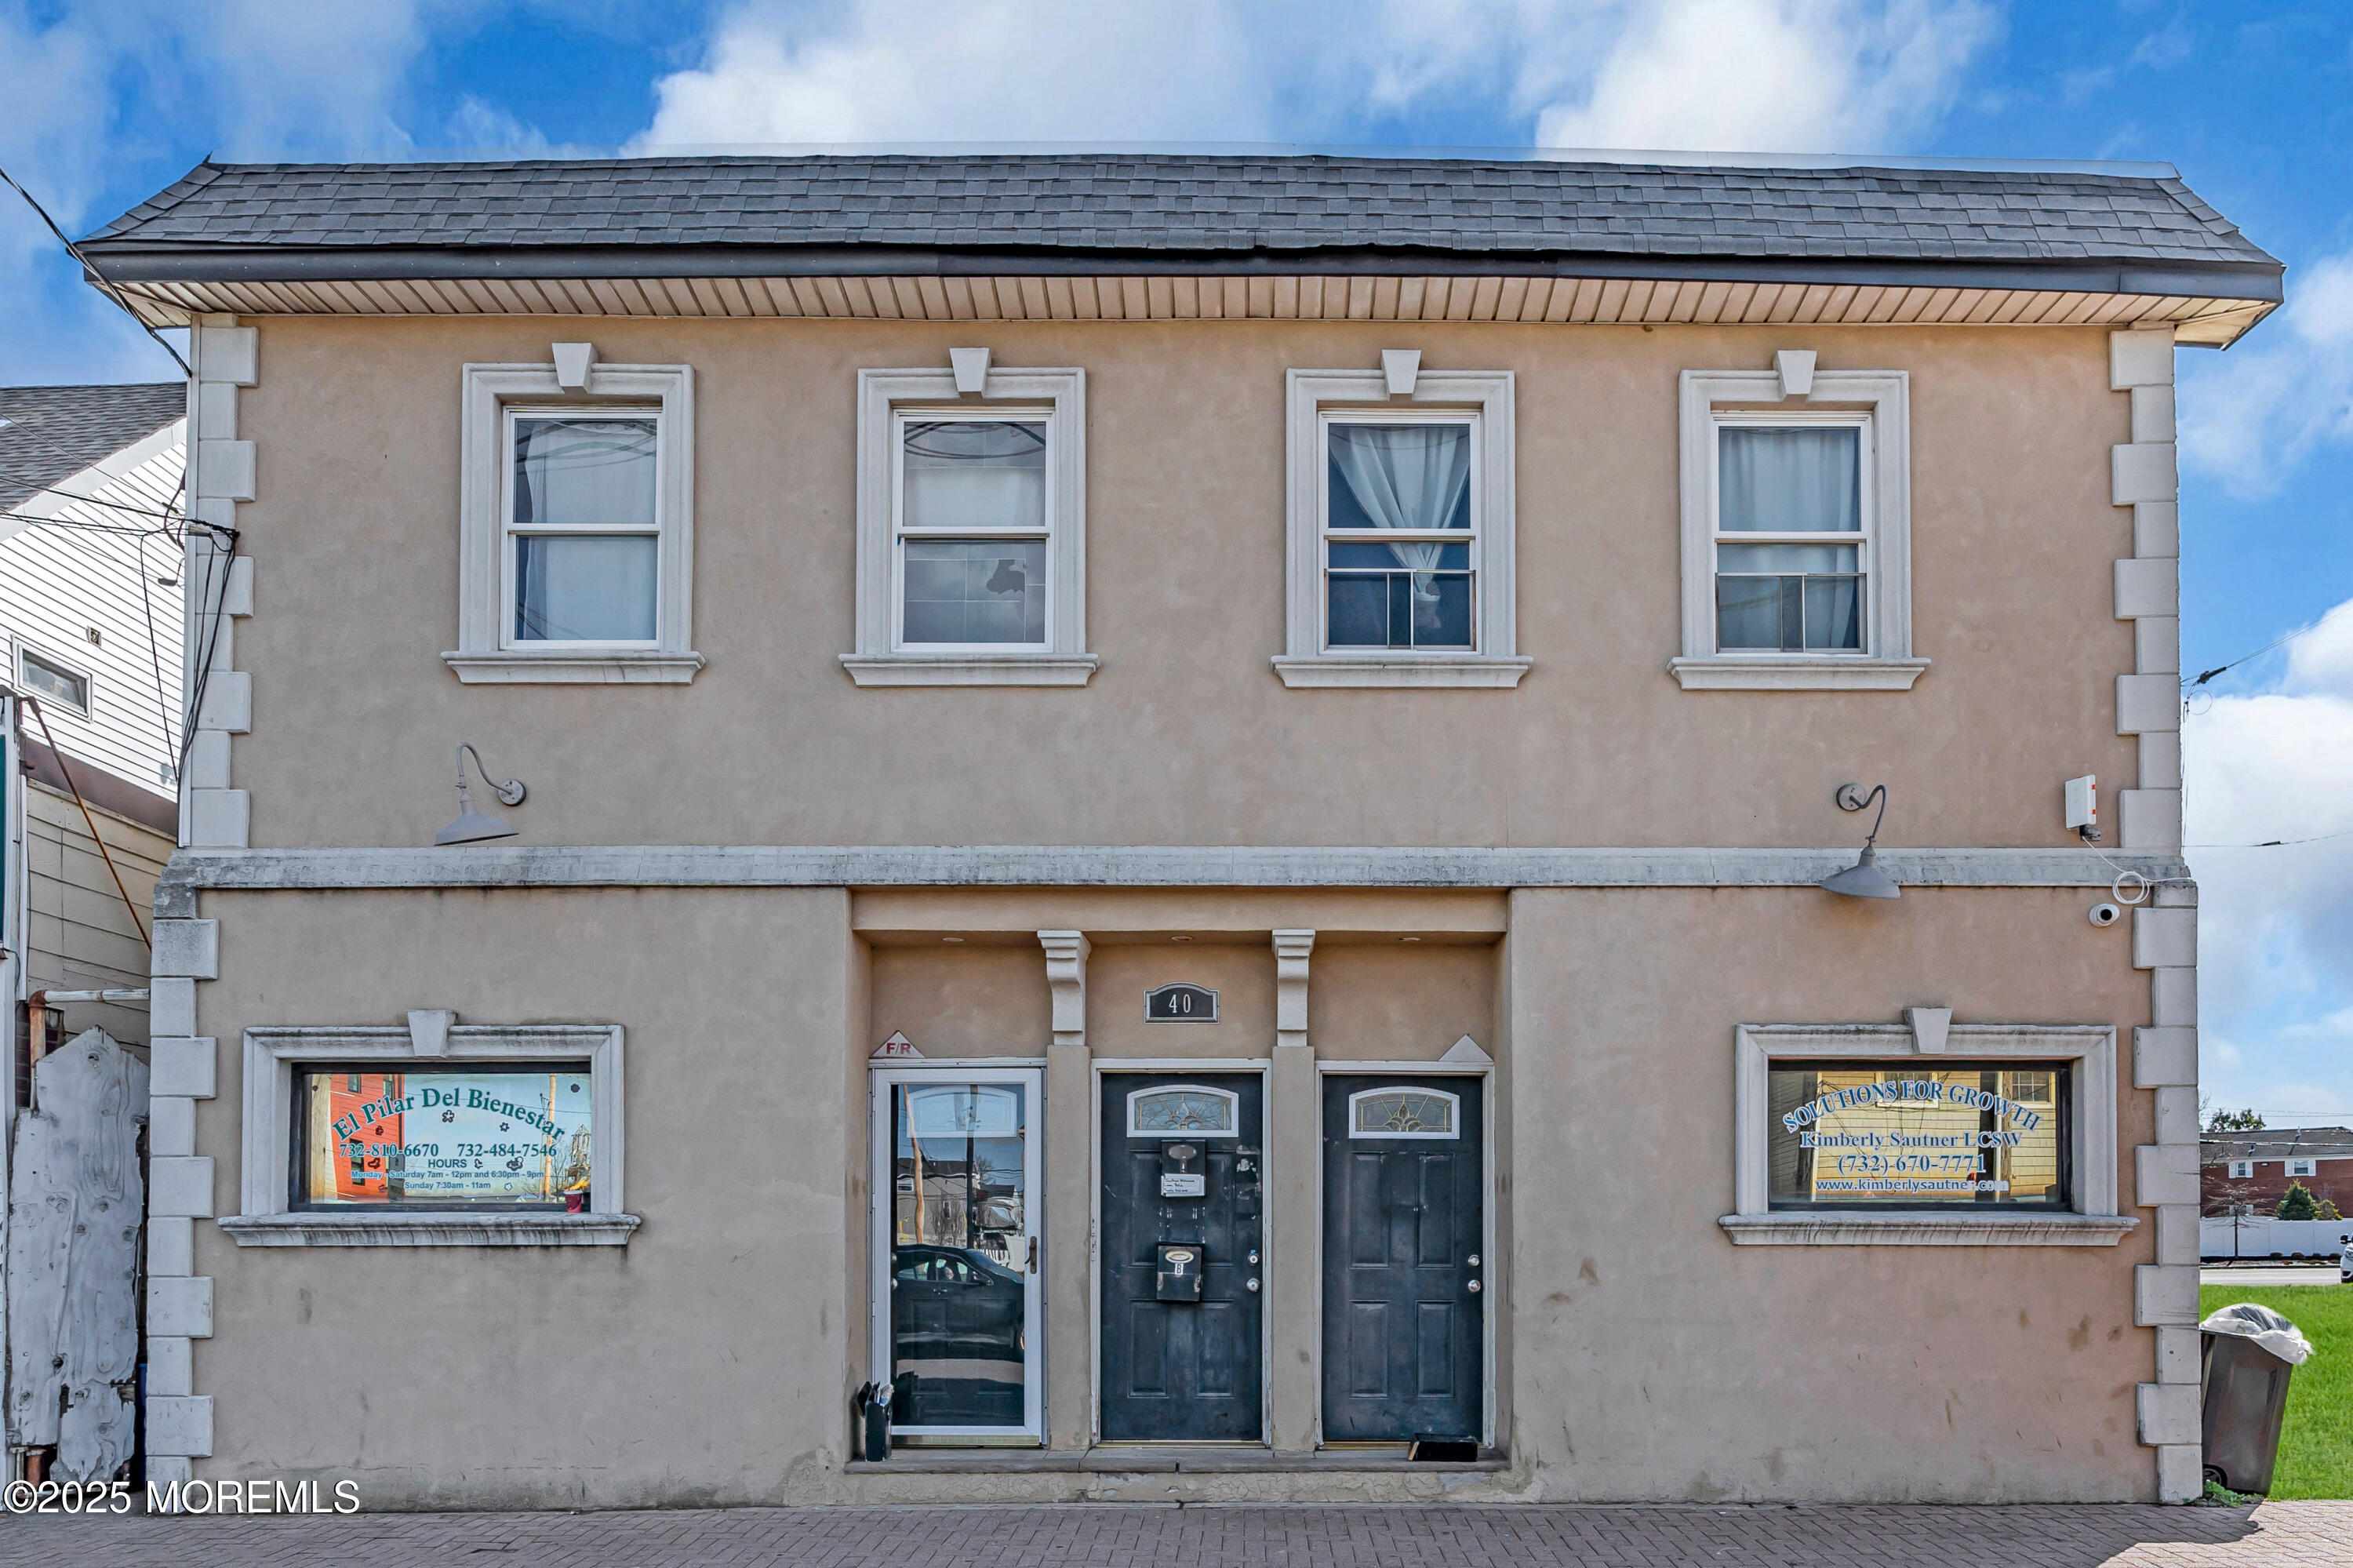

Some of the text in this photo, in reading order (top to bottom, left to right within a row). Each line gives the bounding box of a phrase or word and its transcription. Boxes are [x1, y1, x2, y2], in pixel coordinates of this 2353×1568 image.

[1169, 994, 1191, 1013] 40
[886, 1042, 911, 1054] F/R
[333, 1087, 565, 1141] El Pilar Del Bienestar
[1783, 1080, 2041, 1133] SOLUTIONS FOR GROWTH
[1801, 1131, 2022, 1151] Kimberly Sautner LCSW
[340, 1144, 557, 1157] 732-810-6670 732-484-7546
[428, 1159, 467, 1168] HOURS
[1838, 1154, 1987, 1176] (732) 670-7771
[351, 1170, 383, 1179] Monday
[390, 1170, 425, 1179] Saturday
[451, 1170, 472, 1179] 12pm
[491, 1170, 519, 1179] 6:30pm
[526, 1170, 544, 1179] 9pm
[1176, 1264, 1182, 1274] B
